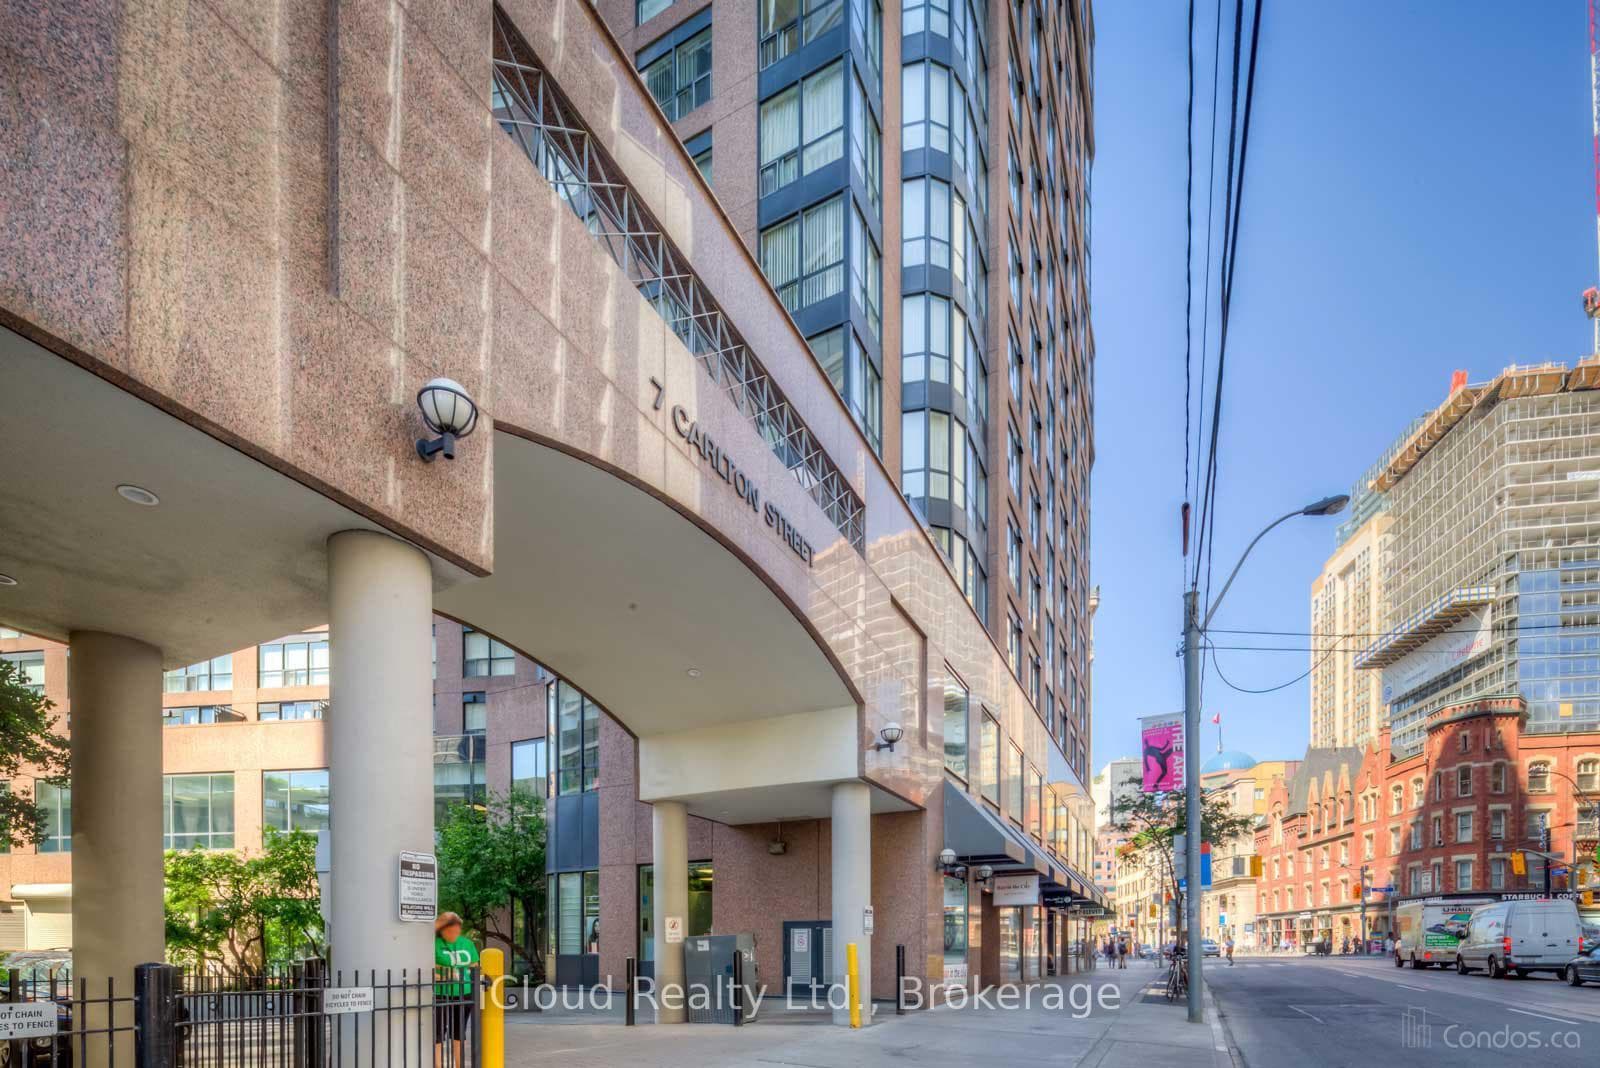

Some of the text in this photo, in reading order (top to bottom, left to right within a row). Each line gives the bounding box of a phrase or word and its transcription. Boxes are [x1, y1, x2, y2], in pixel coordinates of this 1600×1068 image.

[649, 376, 815, 568] 7 CARLTON STREET
[1172, 725, 1186, 791] THE ARTS
[443, 950, 471, 966] TD
[15, 1010, 43, 1019] CHAIN
[12, 1022, 24, 1030] TO
[27, 1020, 55, 1029] FENCE
